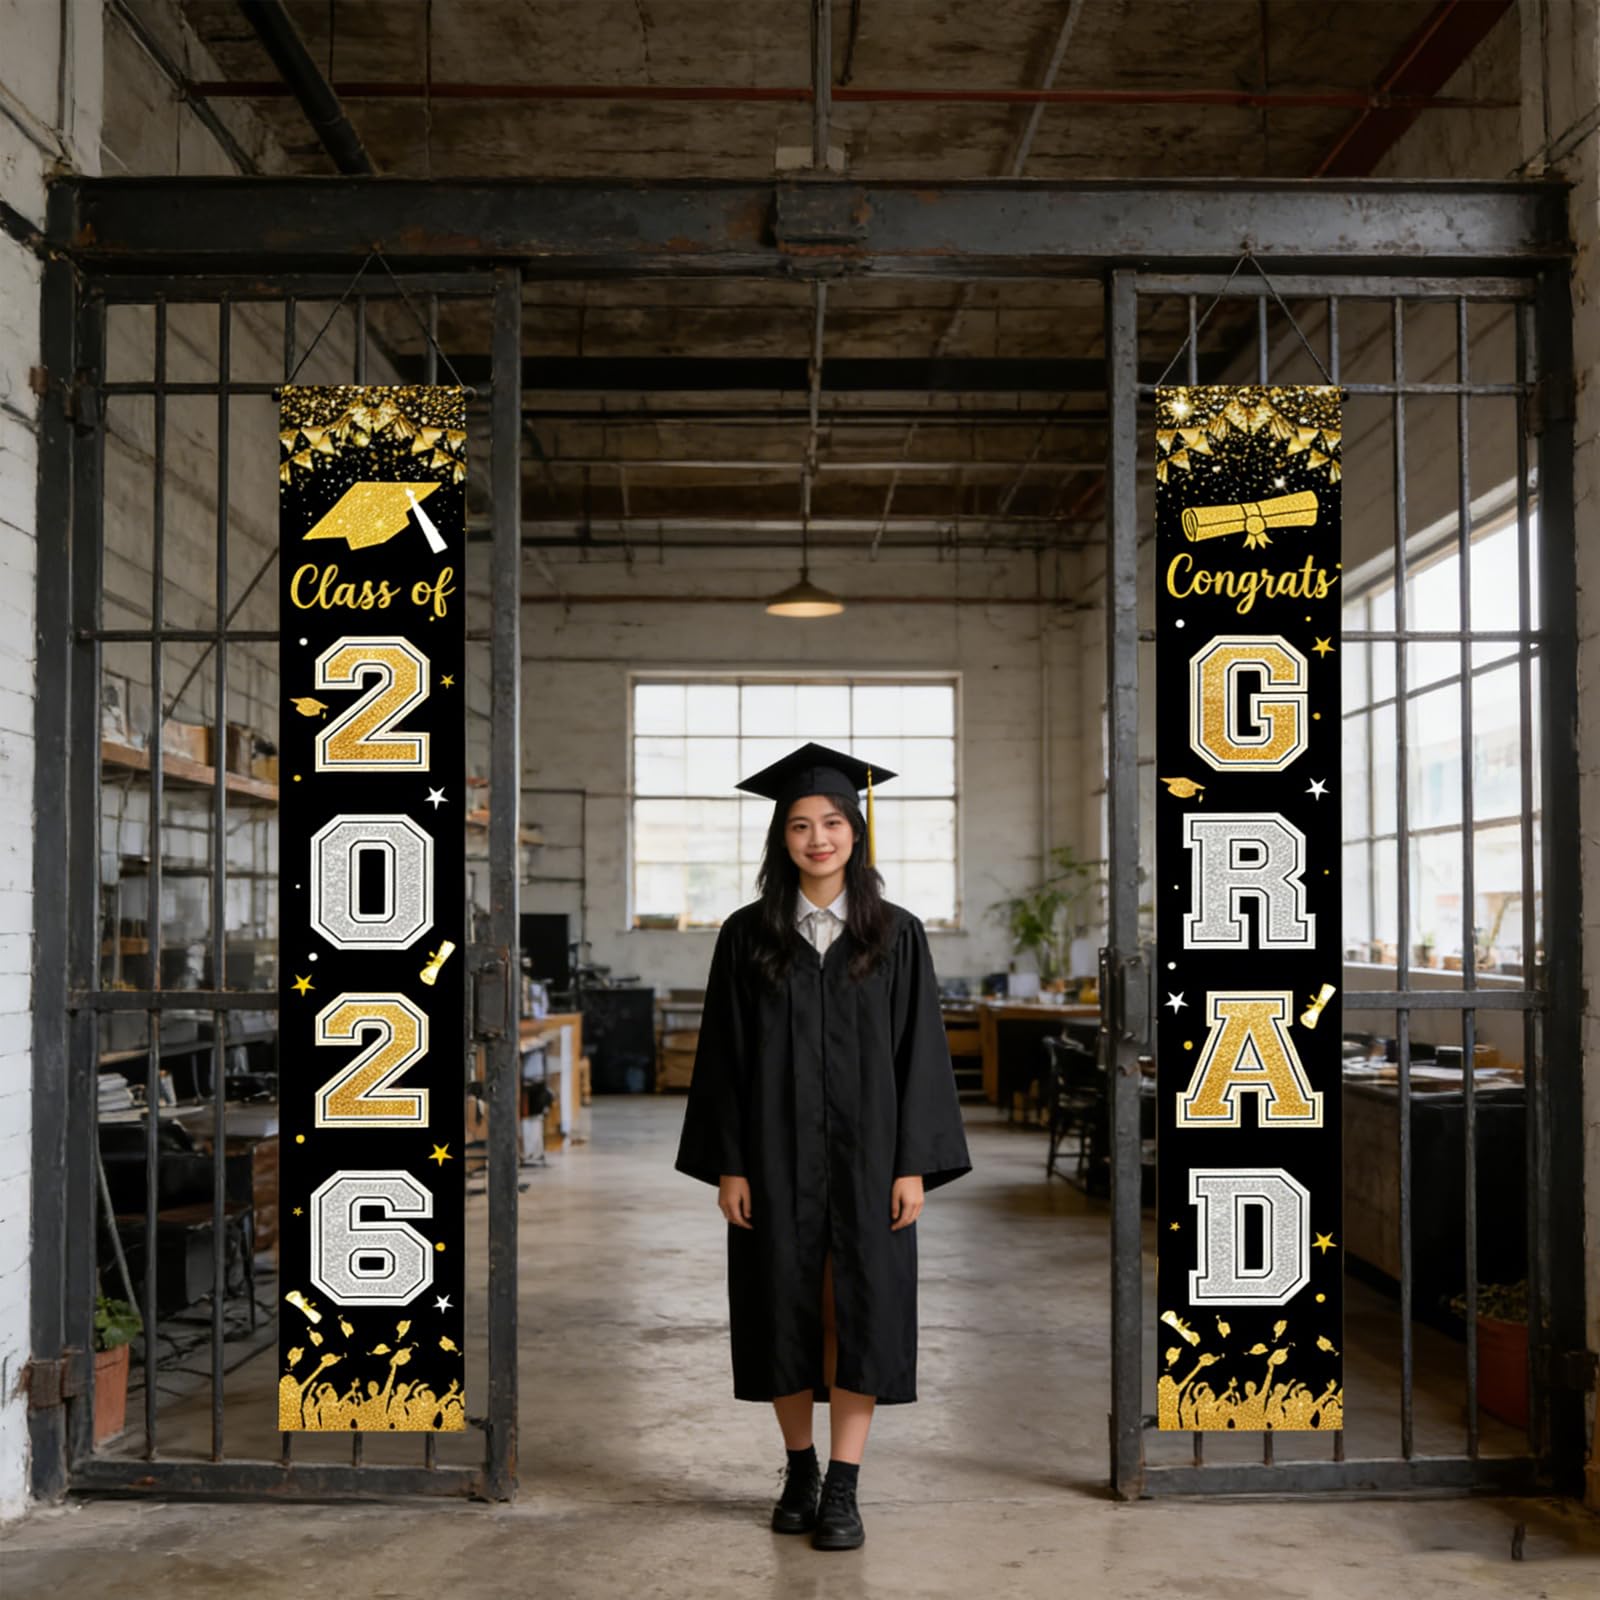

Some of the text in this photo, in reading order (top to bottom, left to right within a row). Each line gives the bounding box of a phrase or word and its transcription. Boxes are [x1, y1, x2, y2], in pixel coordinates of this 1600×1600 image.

[290, 563, 456, 618] Class of
[1166, 552, 1338, 615] Congrats
[309, 635, 435, 1307] 2026
[1175, 634, 1325, 1307] GRAD
